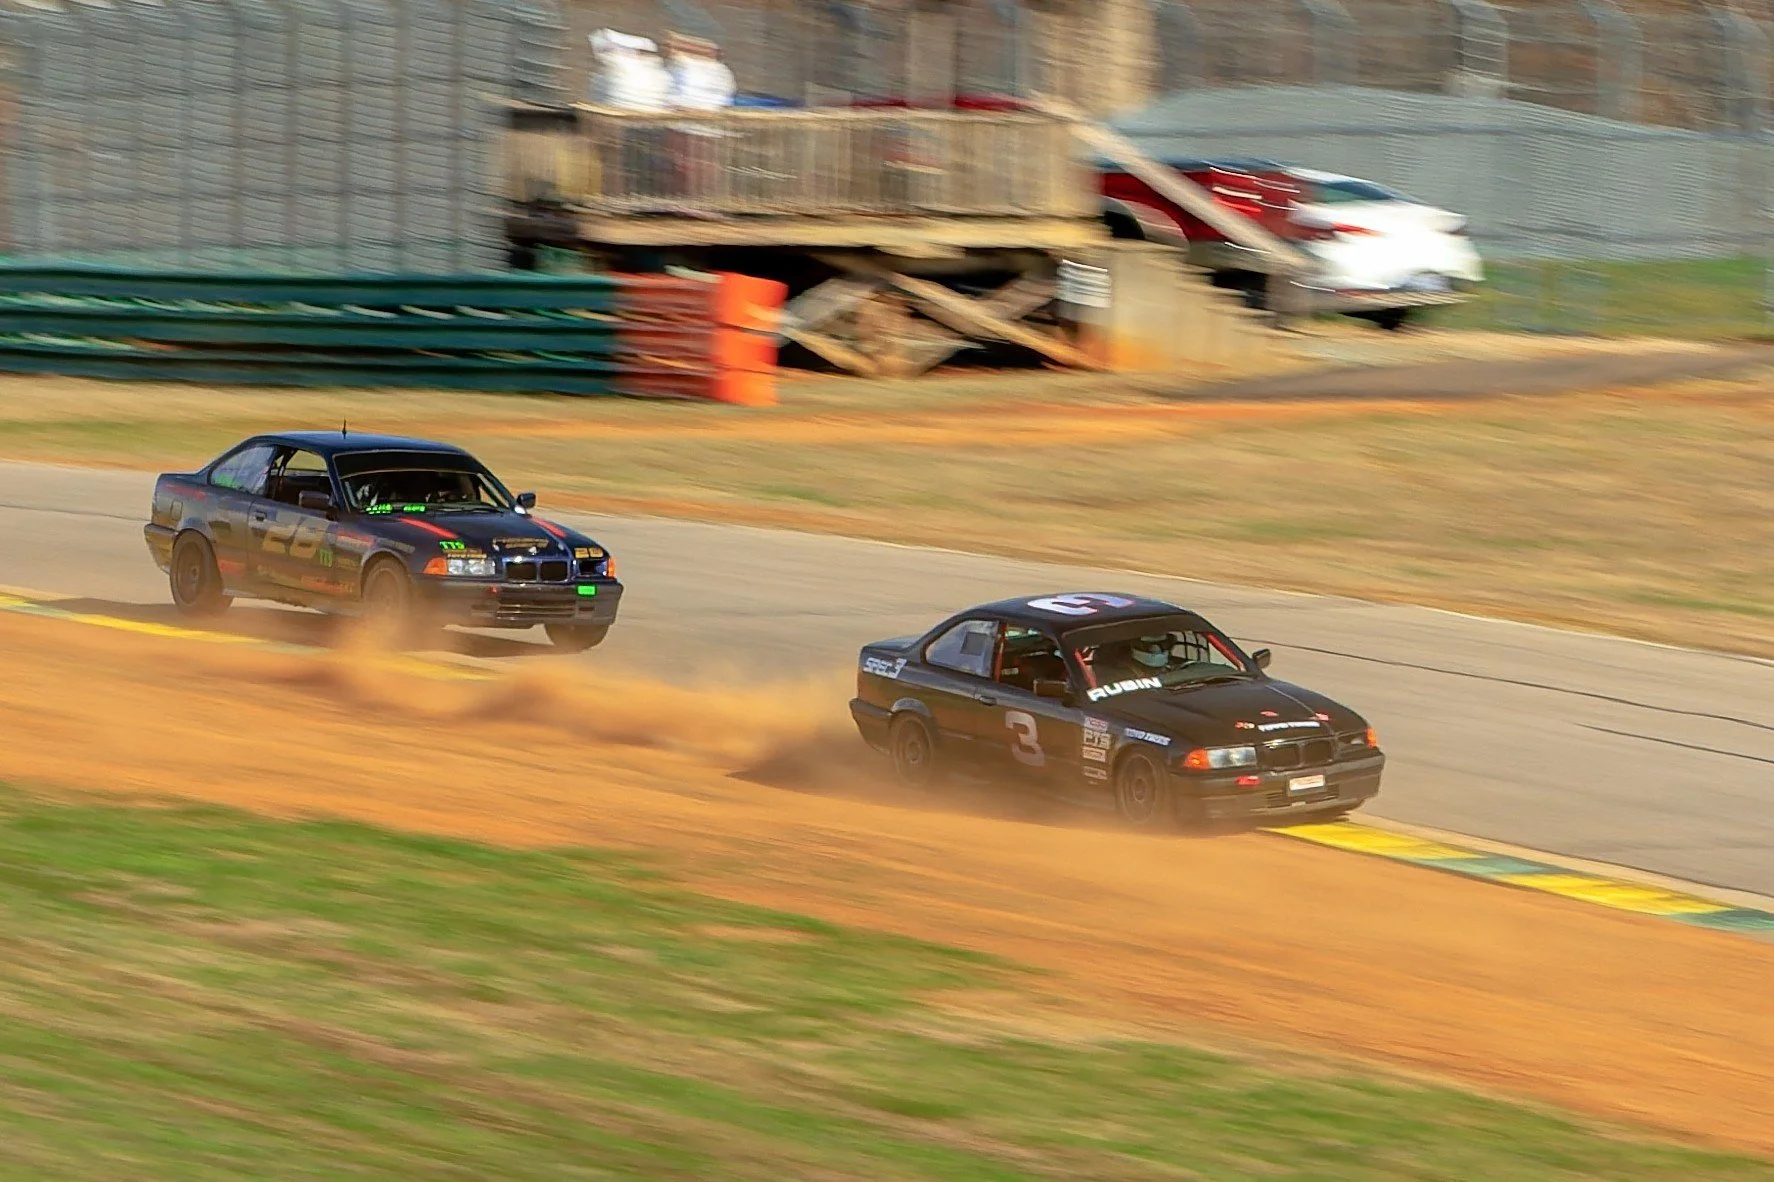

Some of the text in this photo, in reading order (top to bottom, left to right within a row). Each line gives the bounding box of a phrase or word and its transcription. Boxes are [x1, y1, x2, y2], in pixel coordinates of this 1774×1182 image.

[1027, 593, 1134, 616] 3
[1086, 676, 1163, 702] RUBIN
[1005, 711, 1046, 767] 3
